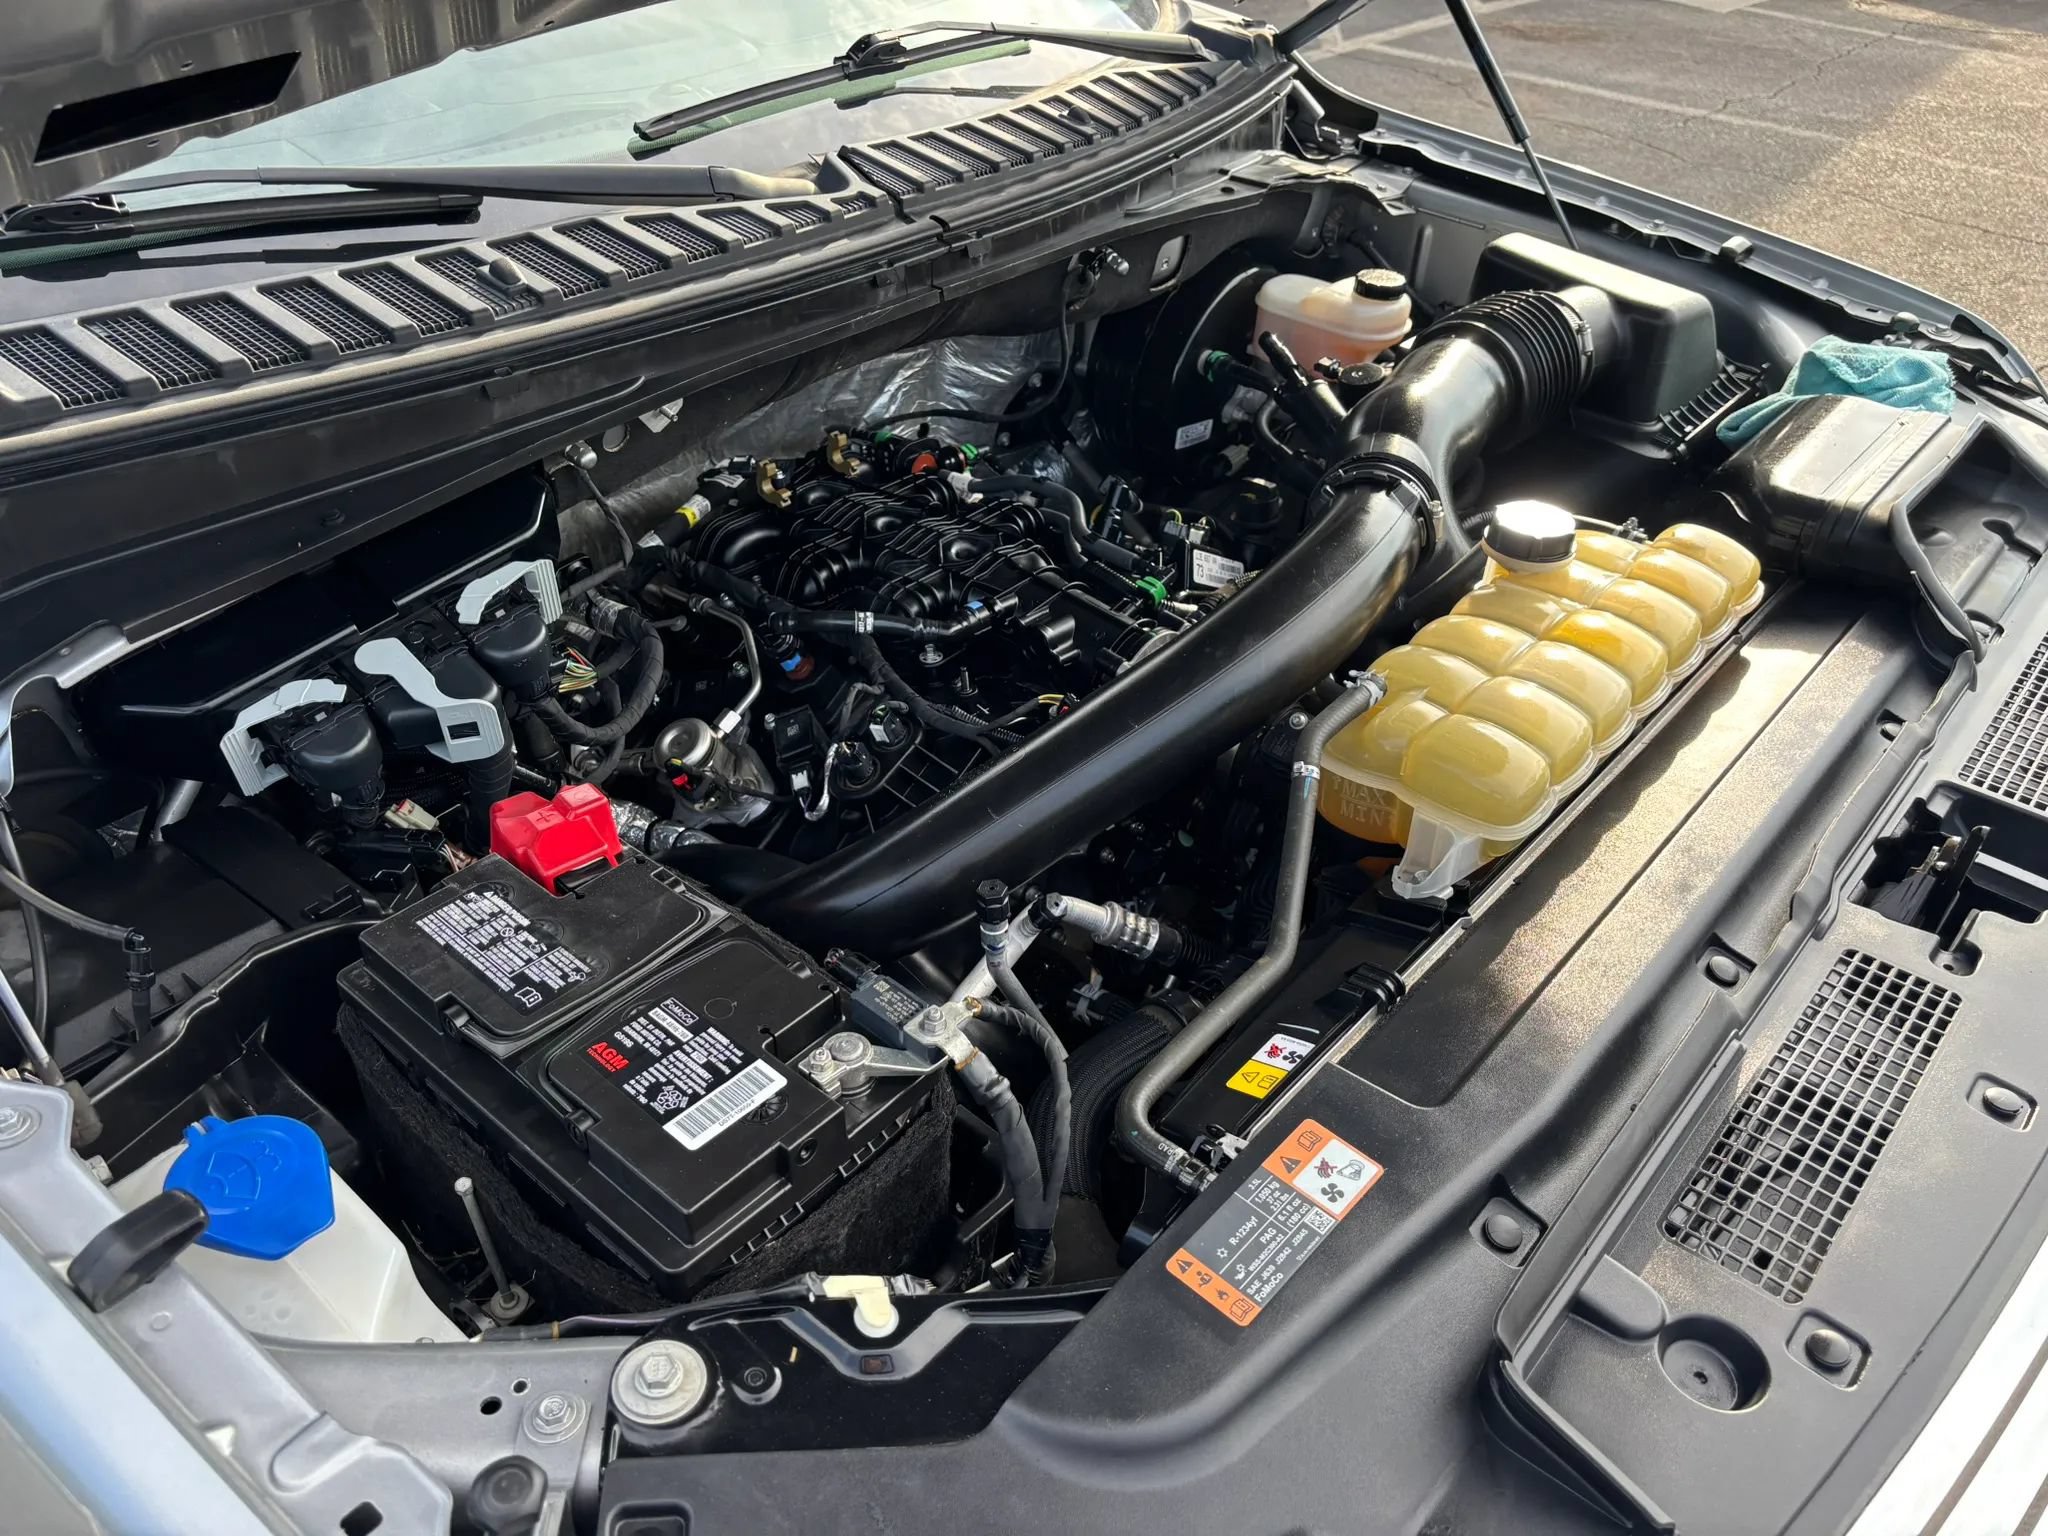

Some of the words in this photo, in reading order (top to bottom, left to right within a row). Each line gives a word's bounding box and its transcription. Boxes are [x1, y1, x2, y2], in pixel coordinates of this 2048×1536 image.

[1342, 779, 1387, 806] MAX
[1340, 800, 1385, 826] MIN
[661, 999, 696, 1023] FoMoCo
[586, 1047, 615, 1073] TECHNOLOGY
[591, 1039, 630, 1070] AGM
[1297, 1202, 1311, 1214] cc)
[1228, 1215, 1260, 1246] R-1234yf
[1259, 1226, 1277, 1244] PAG
[1245, 1279, 1262, 1295] SAE
[1259, 1263, 1276, 1280] J639
[1253, 1270, 1284, 1302] FoMoCo
